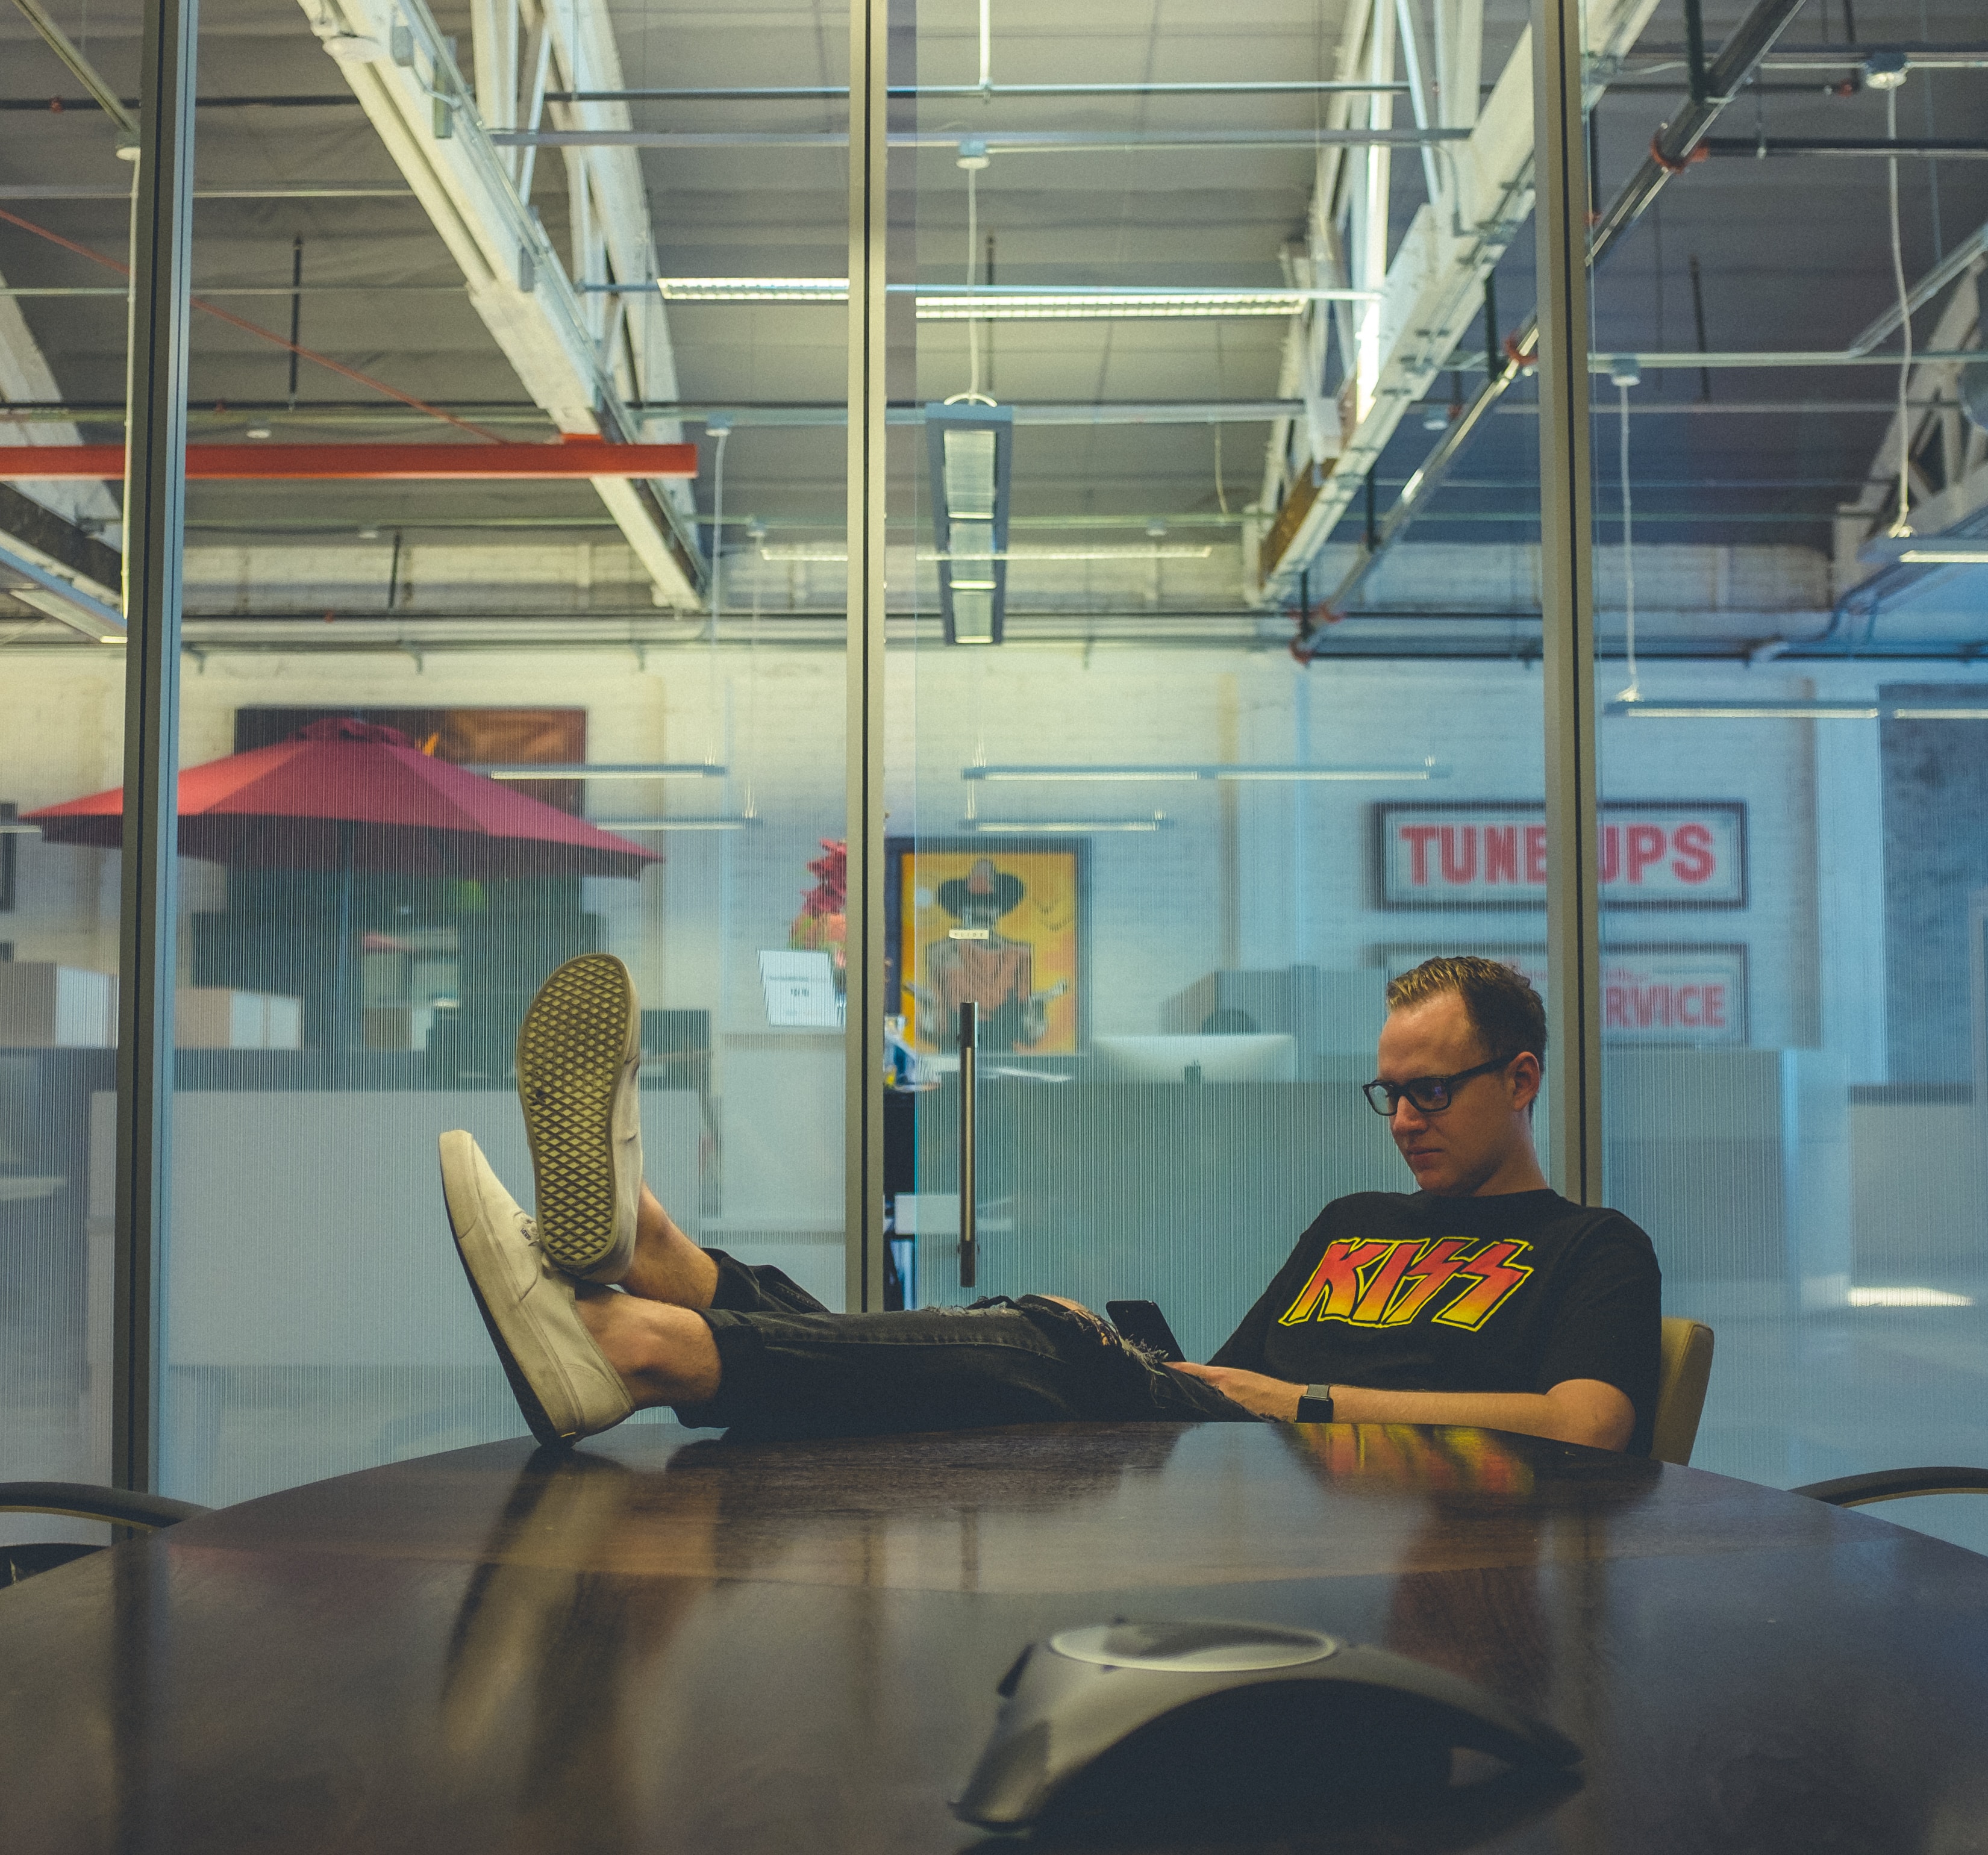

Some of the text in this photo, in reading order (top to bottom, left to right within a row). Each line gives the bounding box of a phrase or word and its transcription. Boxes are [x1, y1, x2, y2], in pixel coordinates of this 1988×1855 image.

[1399, 824, 1546, 886] TUNE
[1605, 984, 1726, 1027] RVICE
[1278, 1236, 1534, 1332] KISS
